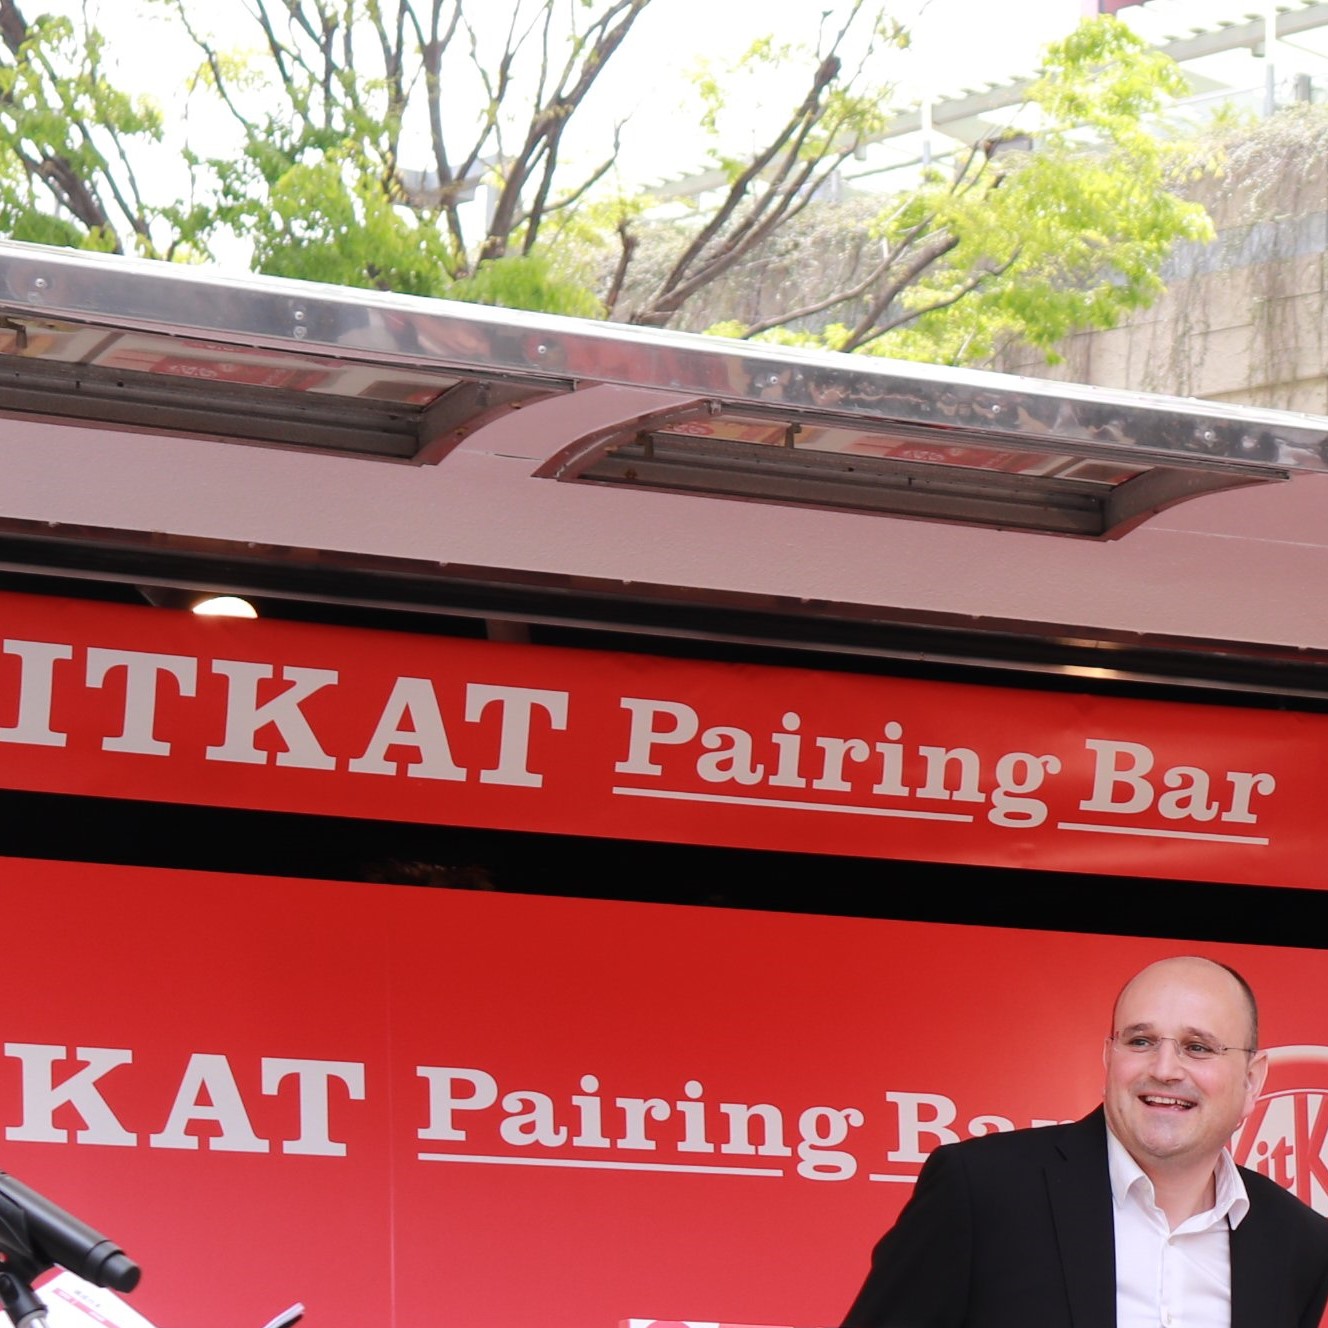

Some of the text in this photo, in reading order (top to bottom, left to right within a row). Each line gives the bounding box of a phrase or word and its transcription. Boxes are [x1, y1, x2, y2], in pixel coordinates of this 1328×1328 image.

[613, 697, 1062, 828] Pairing
[1078, 738, 1277, 824] Bar
[415, 1065, 865, 1182] Pairing
